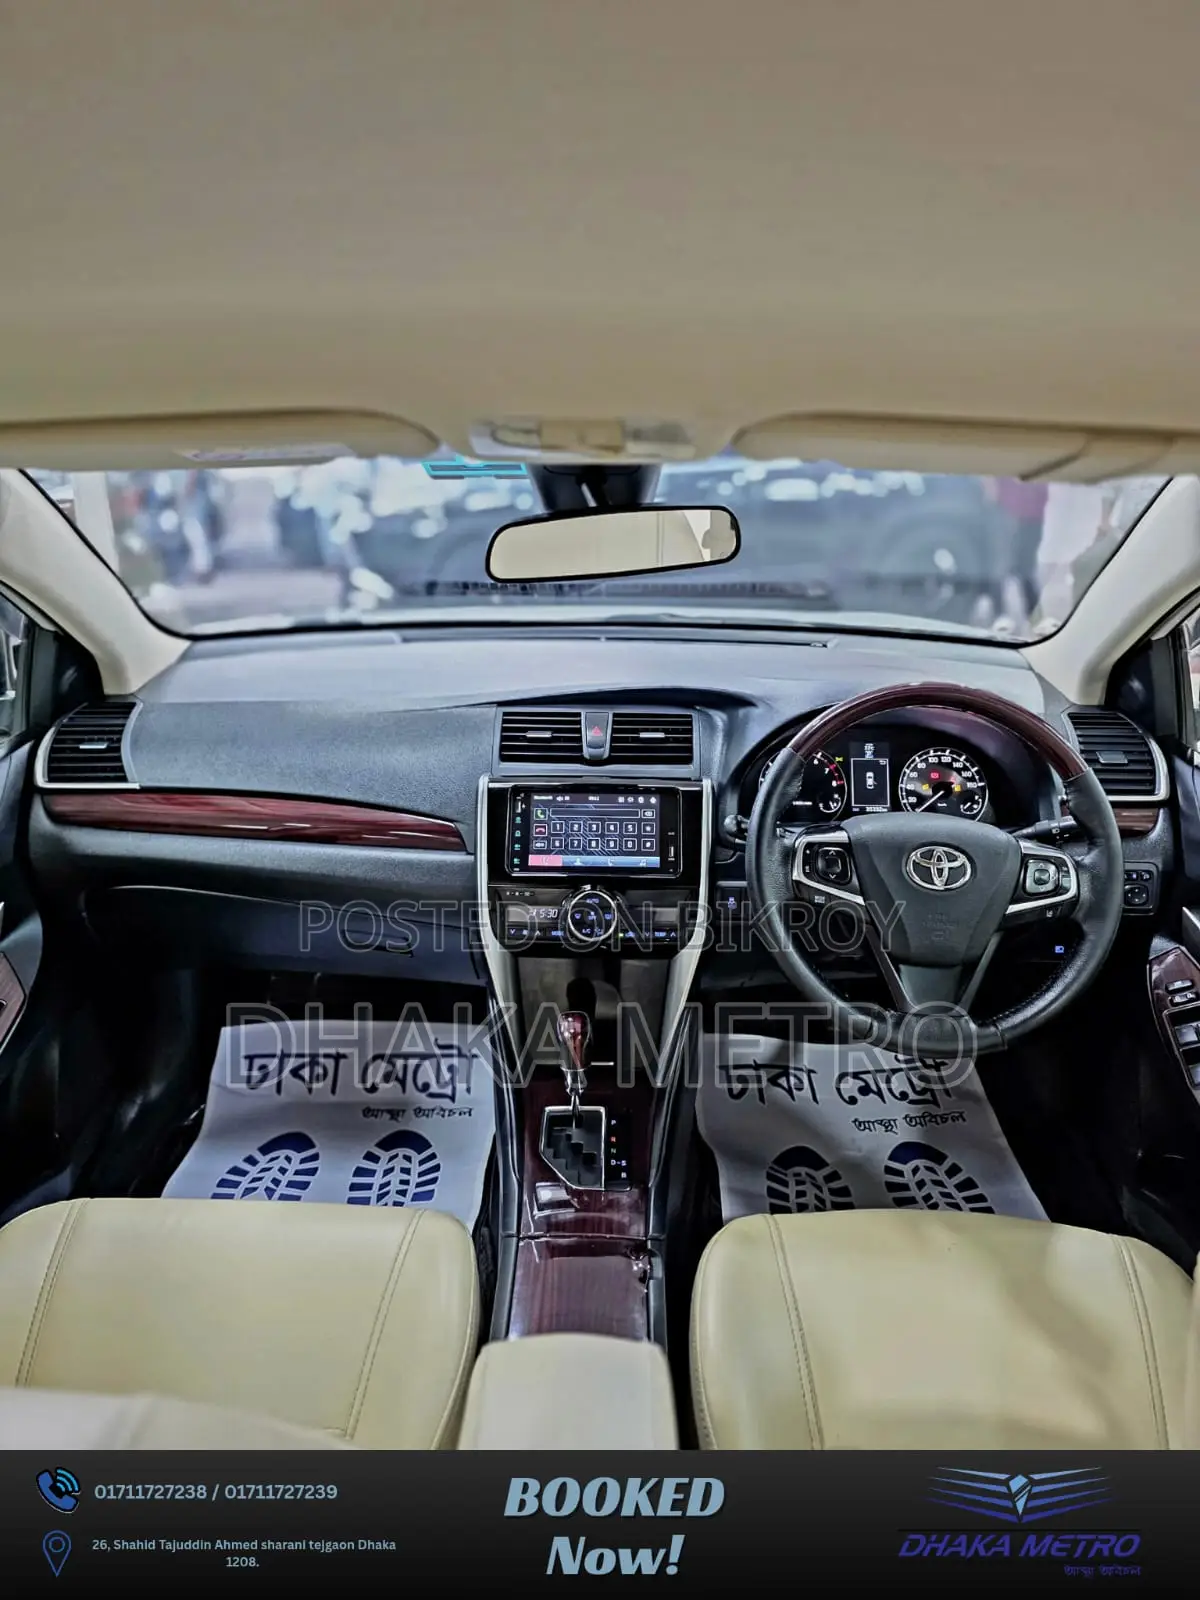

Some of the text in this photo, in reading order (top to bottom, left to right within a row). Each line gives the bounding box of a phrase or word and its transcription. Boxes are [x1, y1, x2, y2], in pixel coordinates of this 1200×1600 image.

[243, 1038, 481, 1104] ঢাকা মেট্রো
[717, 1054, 953, 1108] ঢাকা মেট্রো
